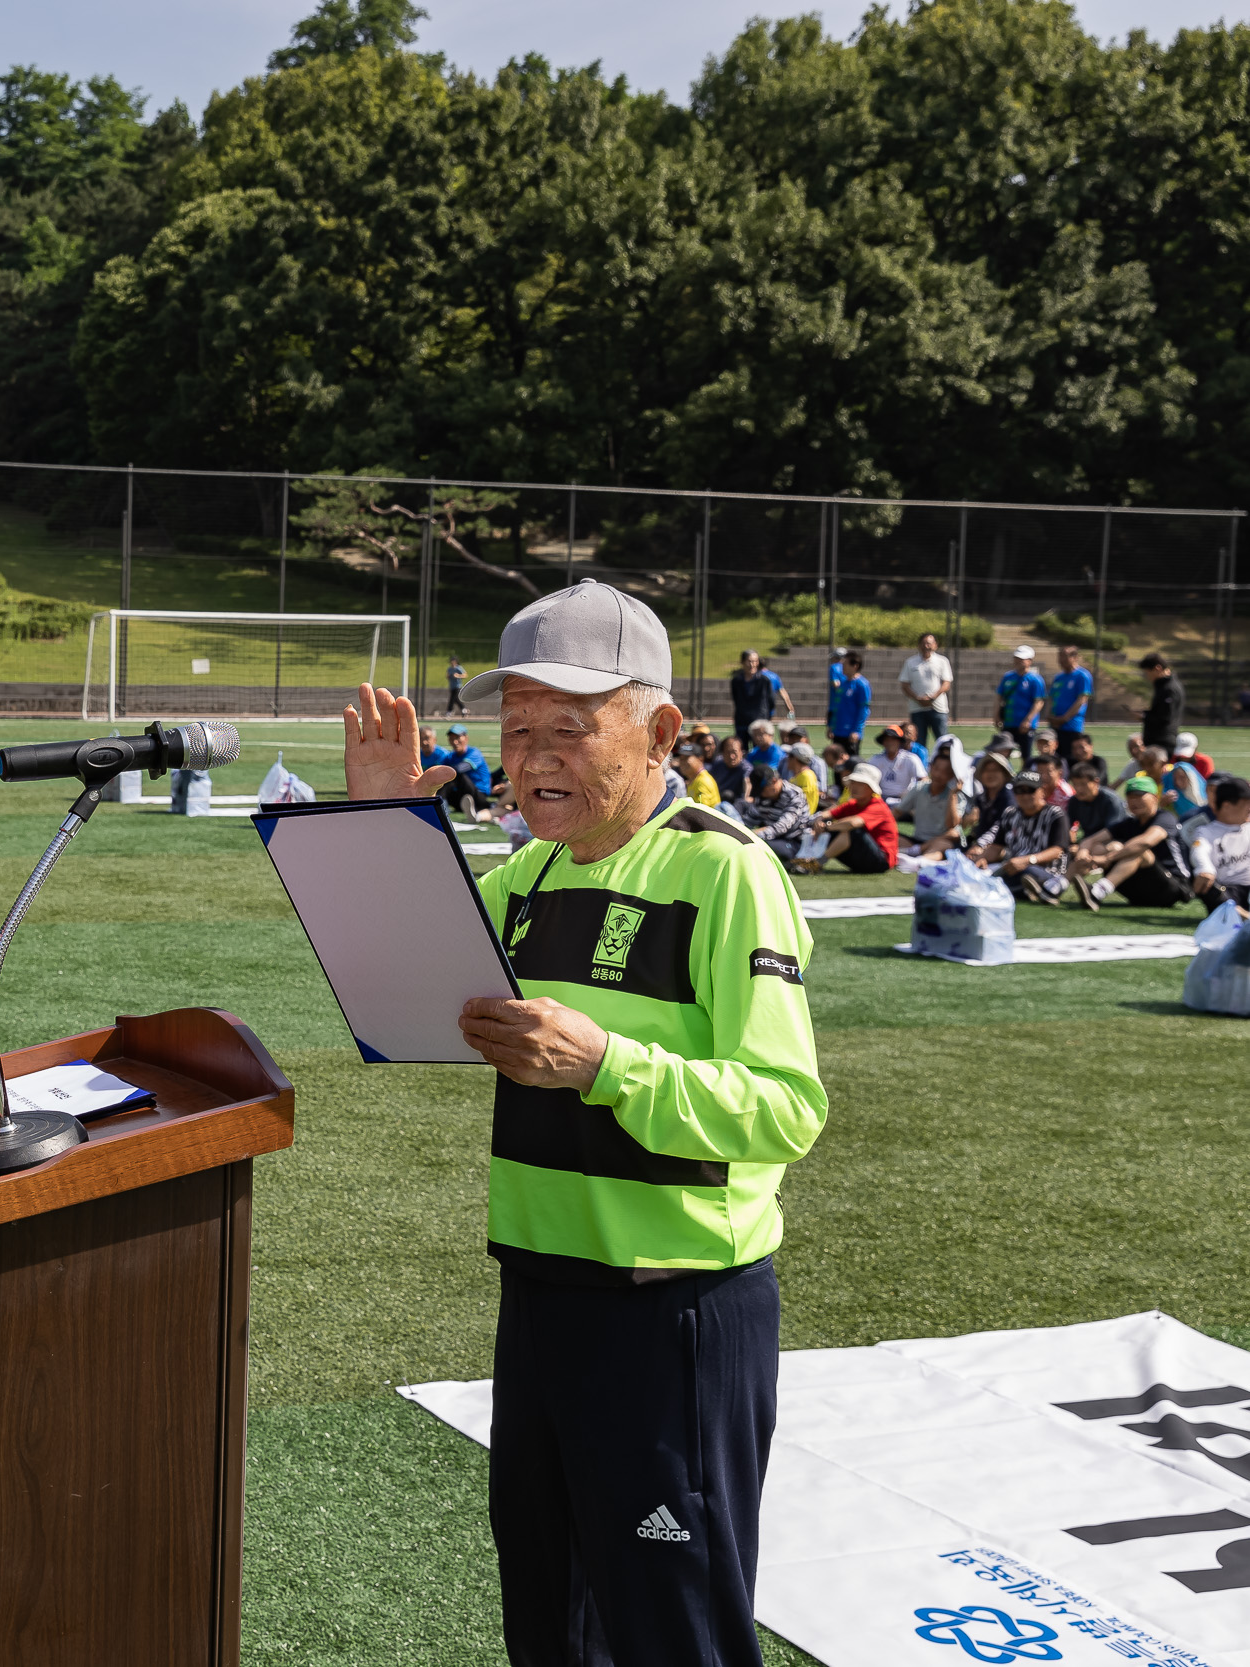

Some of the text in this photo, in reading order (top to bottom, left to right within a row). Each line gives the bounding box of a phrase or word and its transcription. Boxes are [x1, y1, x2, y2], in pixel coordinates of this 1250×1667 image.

[591, 966, 623, 982] 성동80
[754, 957, 798, 975] RESECT
[636, 1526, 691, 1541] adidas
